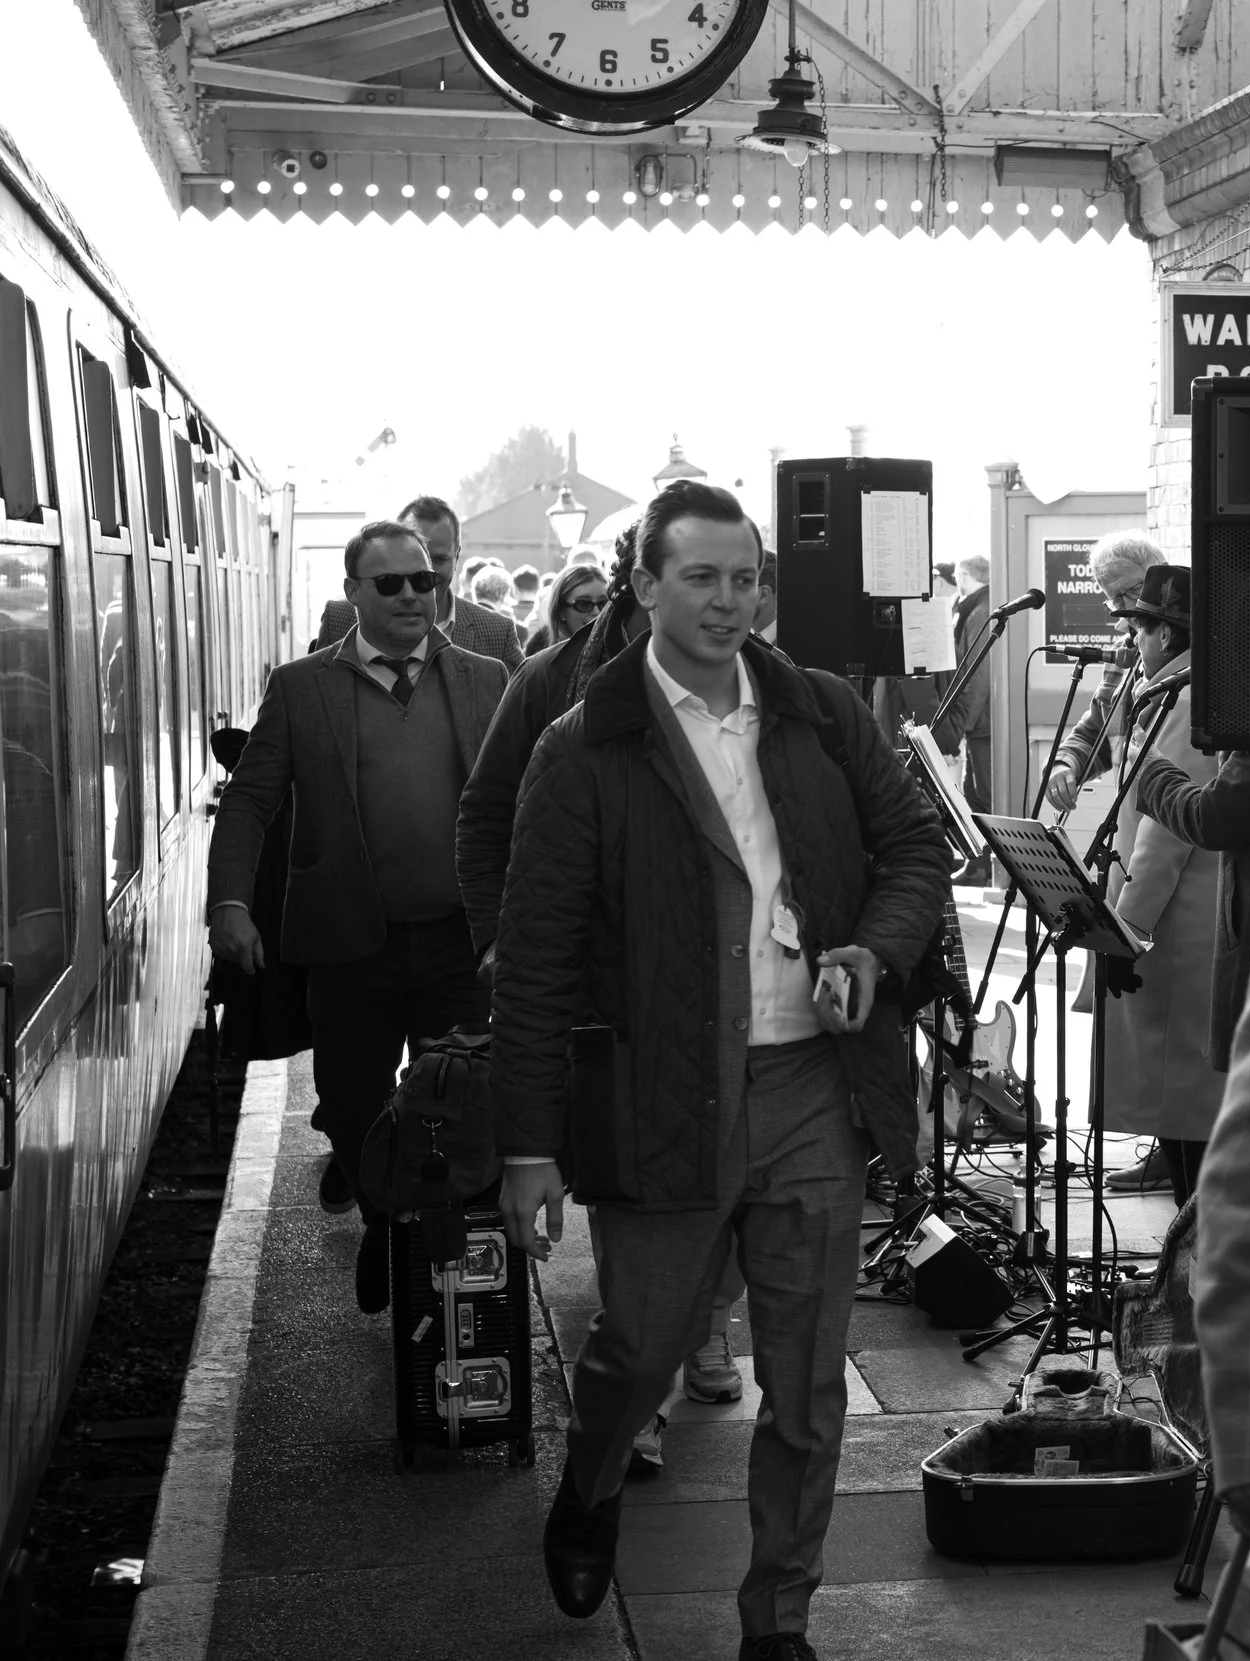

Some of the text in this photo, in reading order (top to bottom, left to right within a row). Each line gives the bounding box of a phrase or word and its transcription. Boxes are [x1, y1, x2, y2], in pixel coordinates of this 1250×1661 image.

[511, 0, 529, 18] 8
[591, 0, 627, 11] GENTS
[688, 3, 708, 29] 4
[548, 32, 566, 57] 7
[651, 38, 669, 64] 5
[599, 49, 617, 74] 6
[1047, 543, 1072, 552] NORTH
[1049, 634, 1077, 643] PLEASE
[1078, 634, 1089, 643] DO
[1090, 634, 1111, 643] COME
